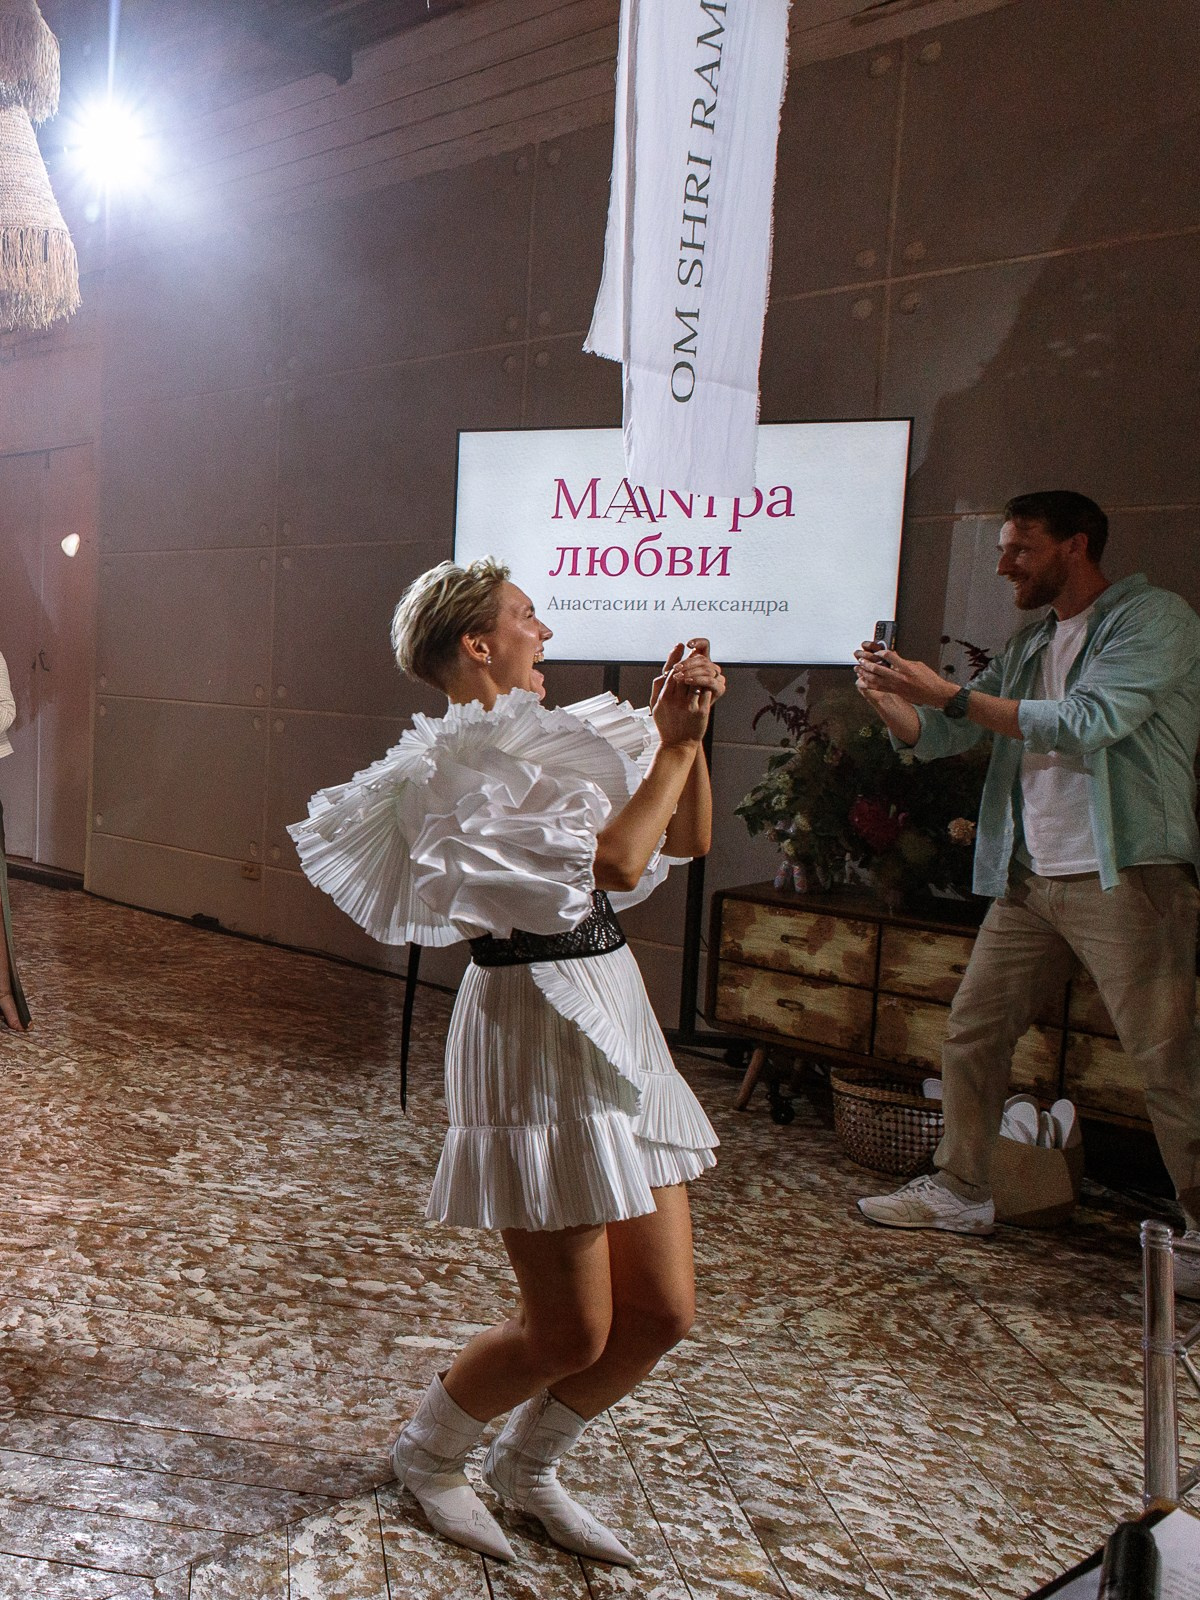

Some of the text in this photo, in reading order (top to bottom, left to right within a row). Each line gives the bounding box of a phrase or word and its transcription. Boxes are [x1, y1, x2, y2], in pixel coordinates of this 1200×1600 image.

[670, 0, 728, 403] OM SHRI RAM
[548, 532, 732, 577] любви
[547, 596, 789, 616] Анастасии и Александра
